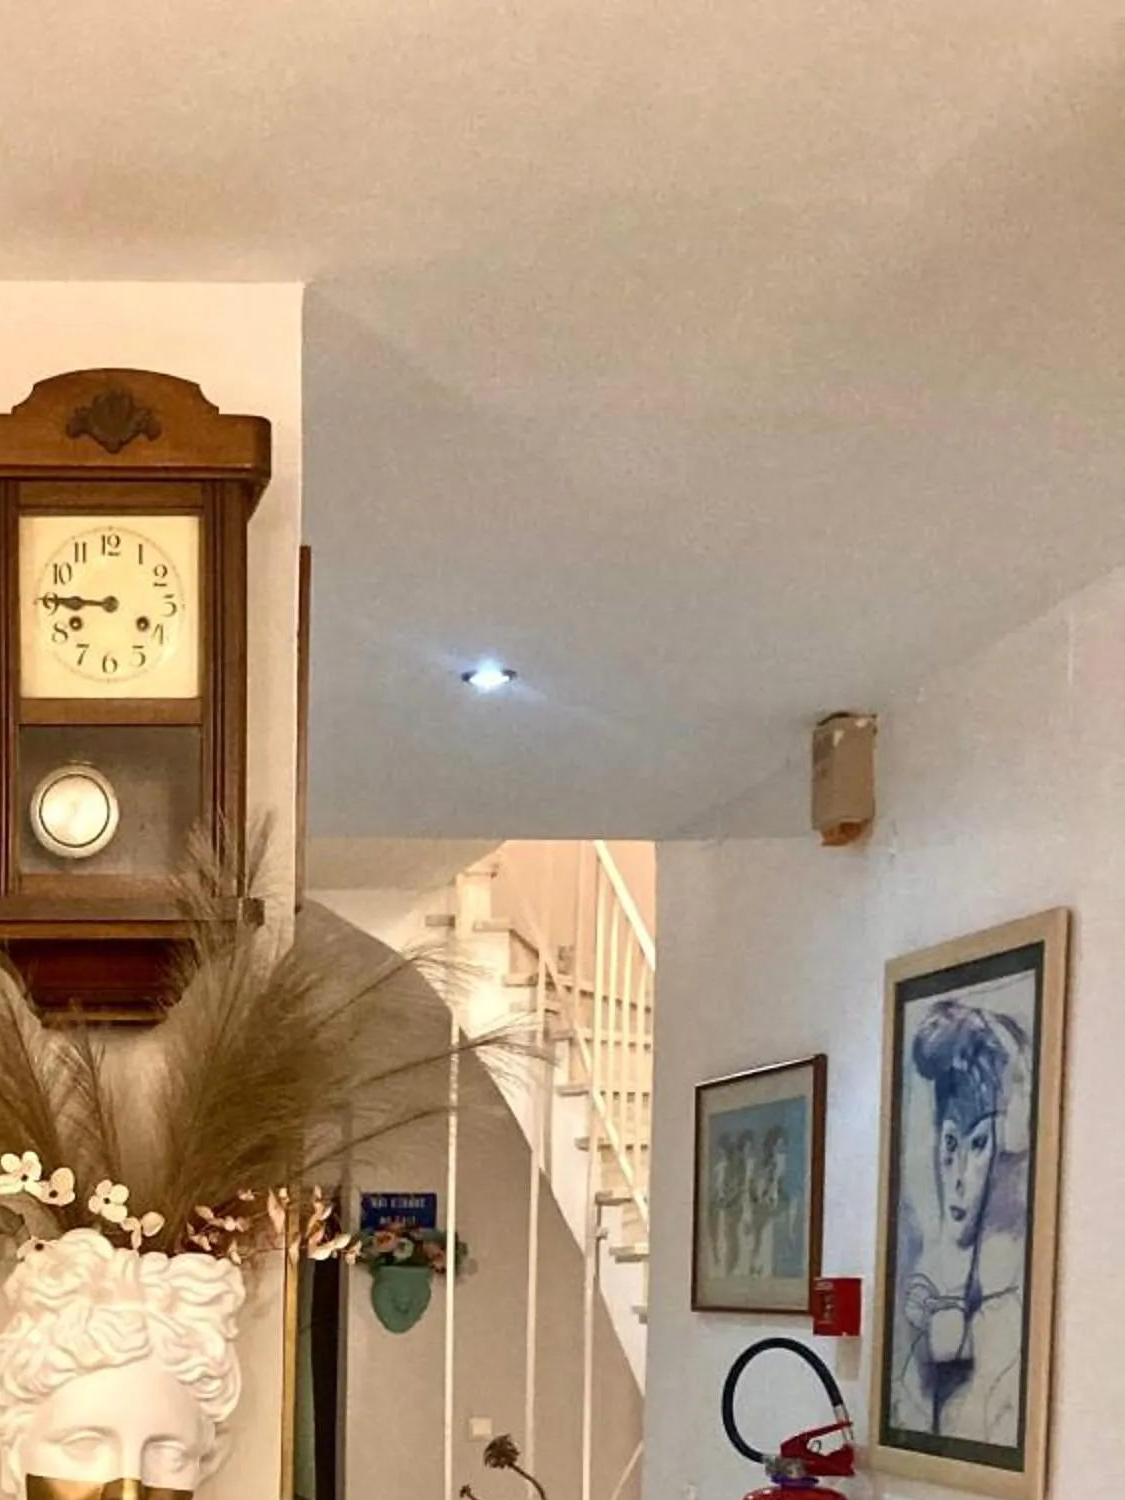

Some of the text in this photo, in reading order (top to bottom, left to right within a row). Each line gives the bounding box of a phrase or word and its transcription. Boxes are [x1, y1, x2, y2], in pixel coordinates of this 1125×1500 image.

[74, 541, 87, 564] 11
[101, 533, 121, 557] 12
[138, 543, 144, 565] 1
[53, 562, 72, 585] 10
[51, 621, 69, 643] 8
[76, 643, 89, 666] 7
[101, 652, 118, 674] 6
